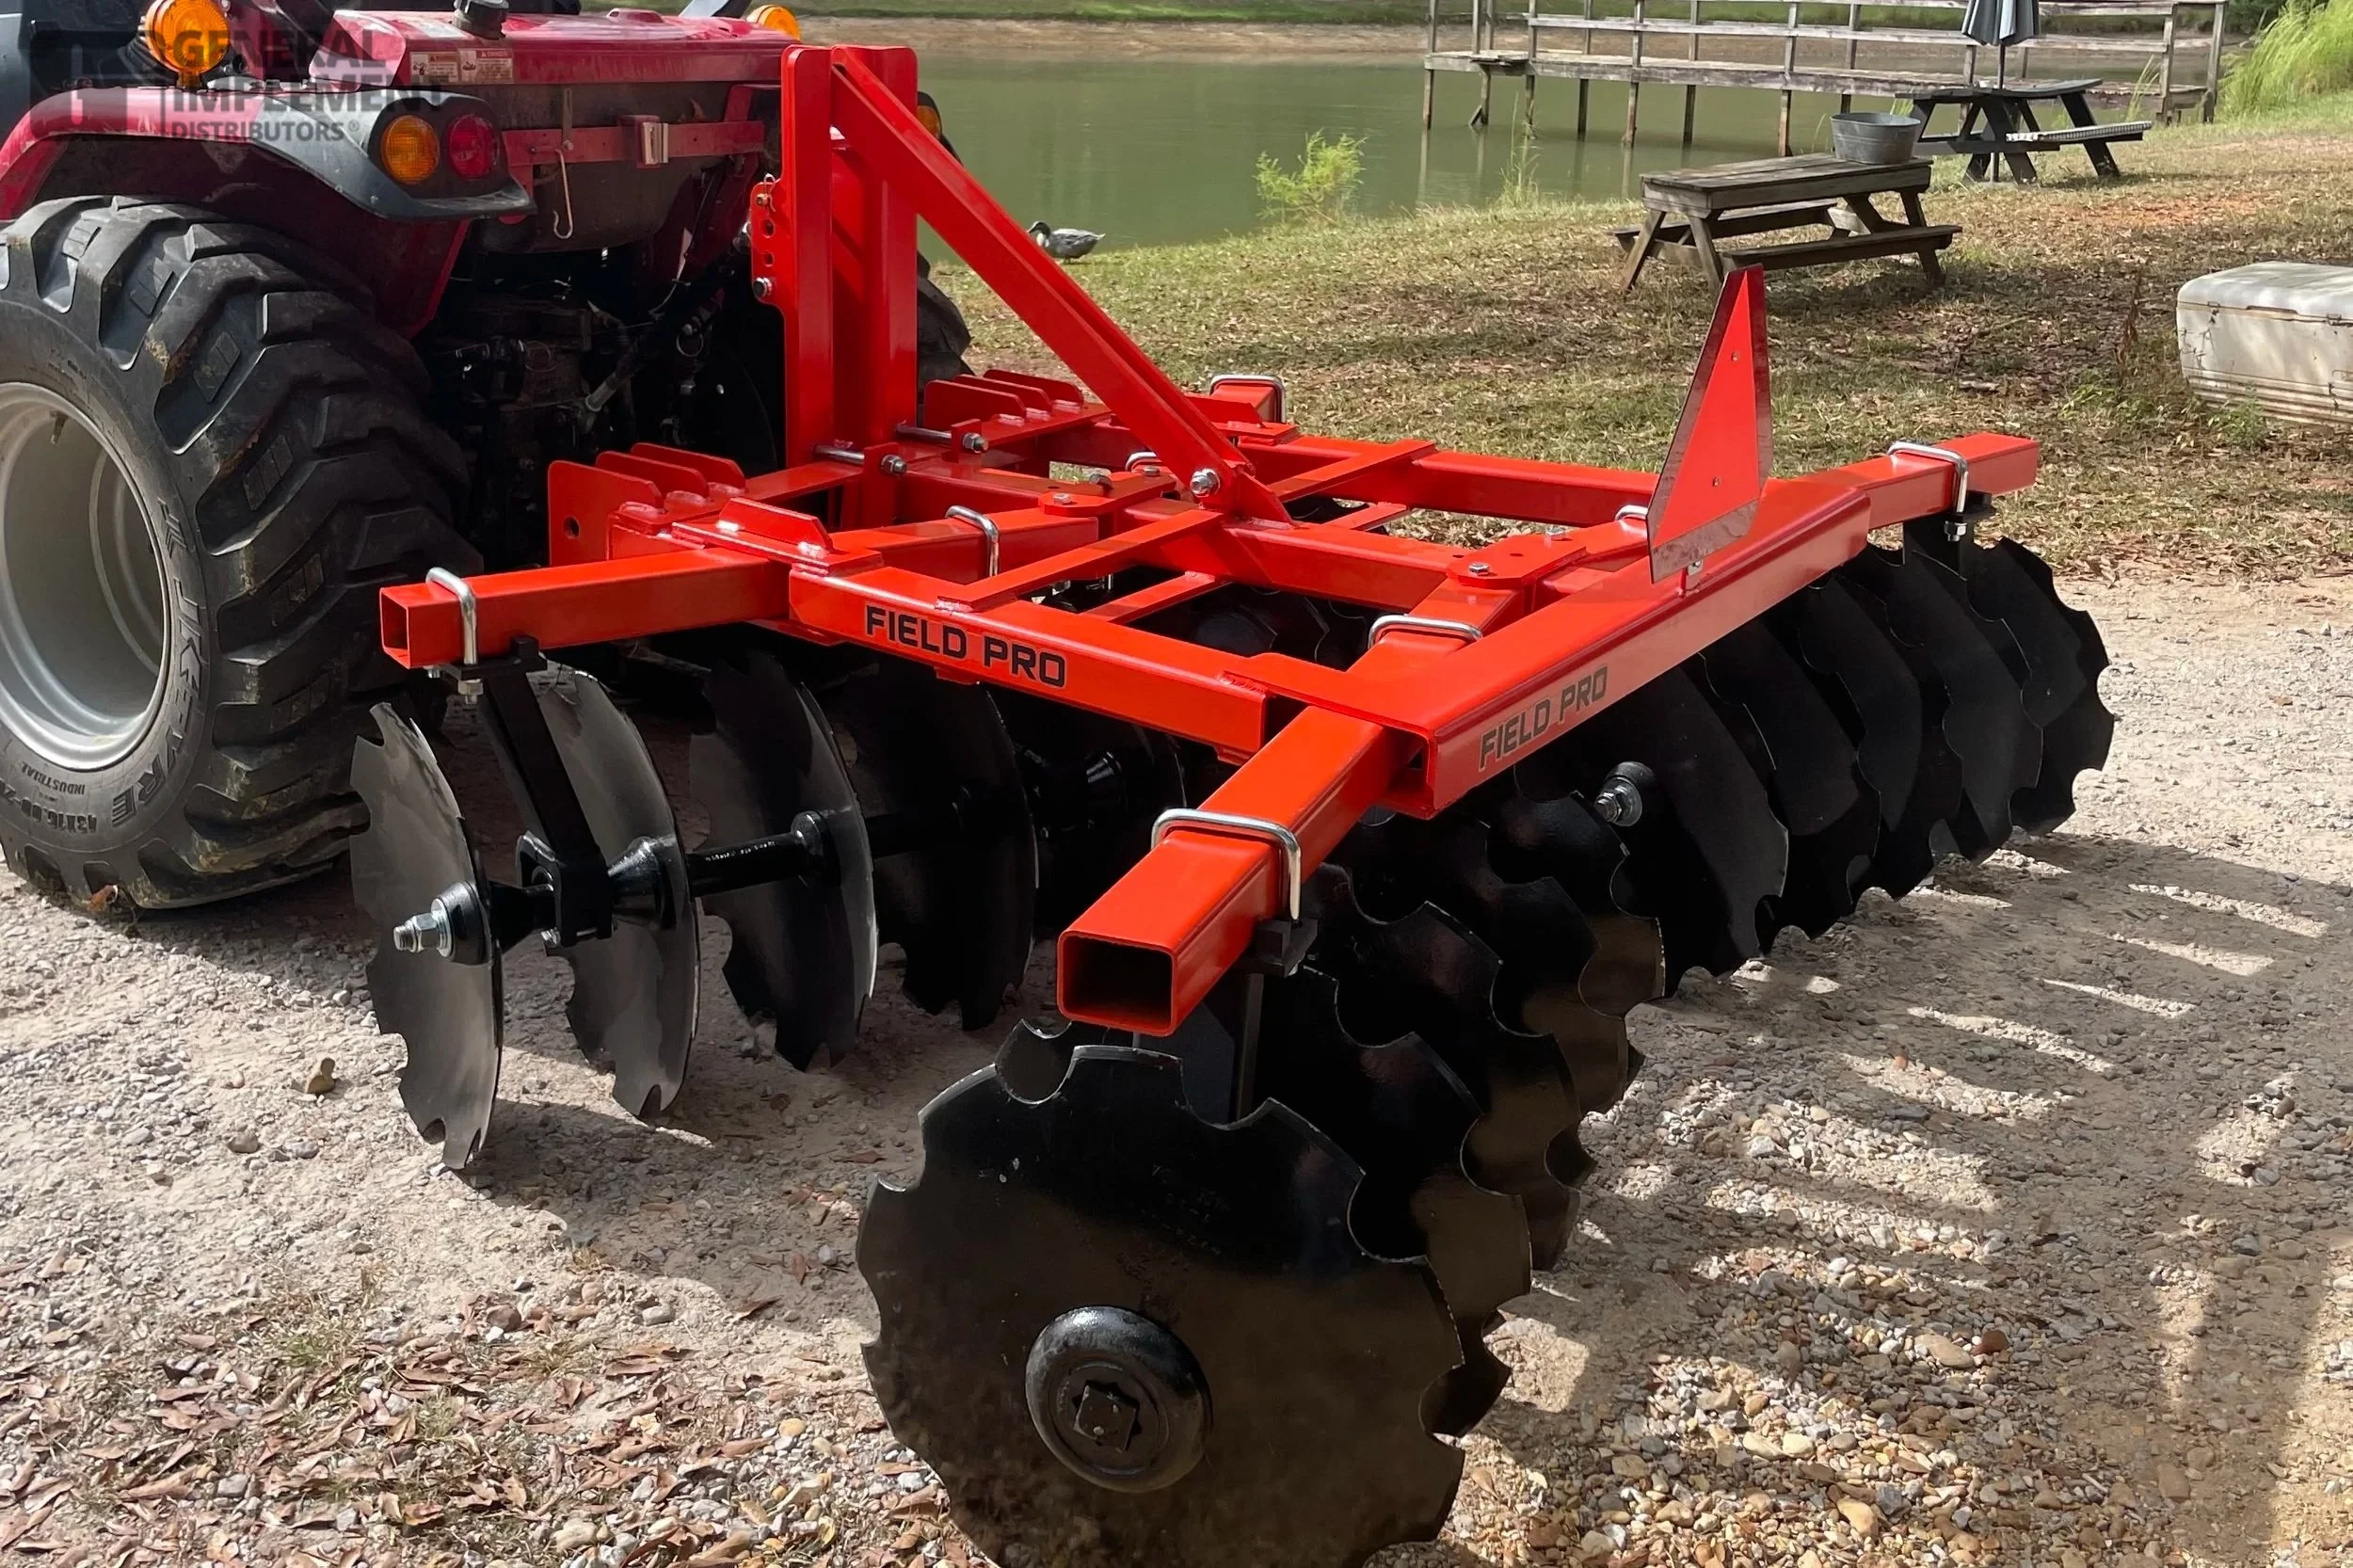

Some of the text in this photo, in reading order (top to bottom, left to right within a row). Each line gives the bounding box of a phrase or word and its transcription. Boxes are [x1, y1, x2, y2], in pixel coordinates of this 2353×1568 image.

[866, 604, 1065, 688] FIELD PRO
[1480, 665, 1609, 770] FIELD PRO
[21, 760, 86, 795] INDUSTRIAL
